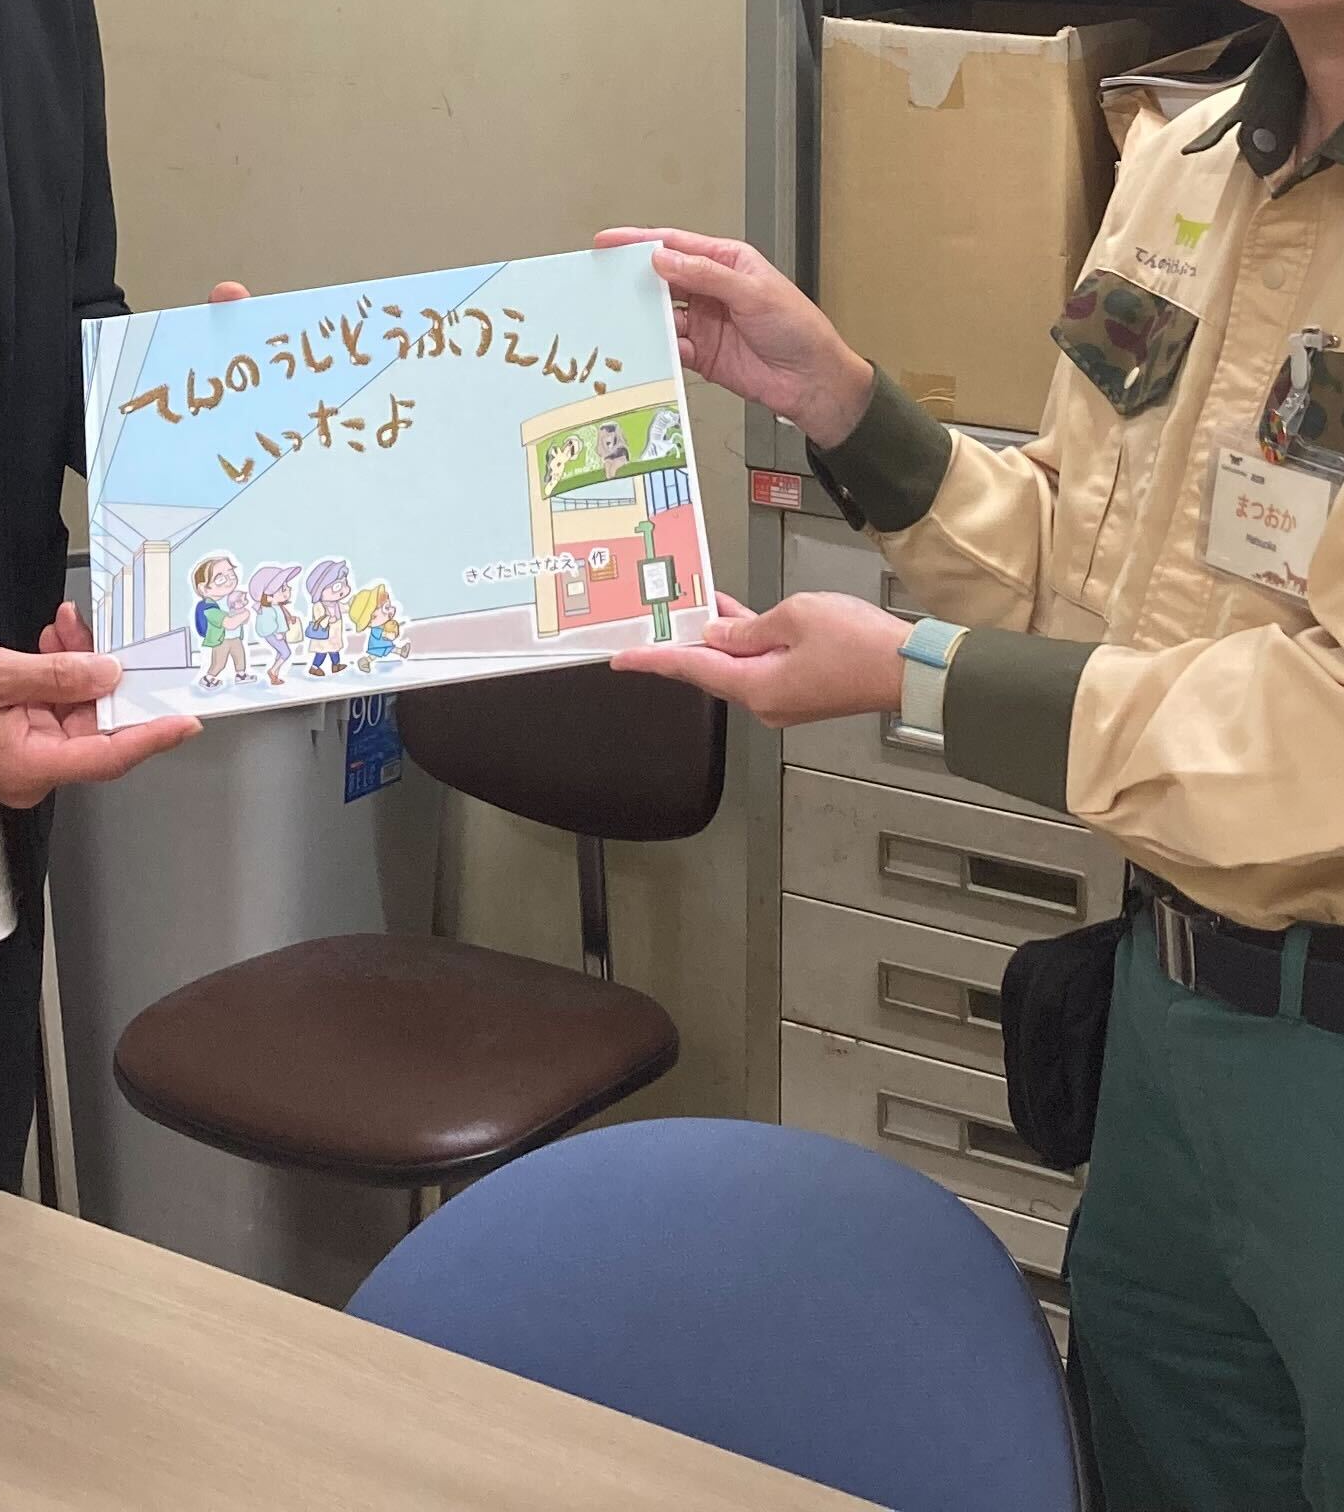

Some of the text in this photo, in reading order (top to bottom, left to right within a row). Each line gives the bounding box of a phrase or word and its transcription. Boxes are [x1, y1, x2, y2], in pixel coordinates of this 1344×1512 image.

[120, 294, 624, 424] てんのうじどうぶつえんに
[217, 394, 416, 484] いったよ
[1236, 494, 1297, 534] まつおか
[465, 549, 607, 583] きくたにさなえ 作
